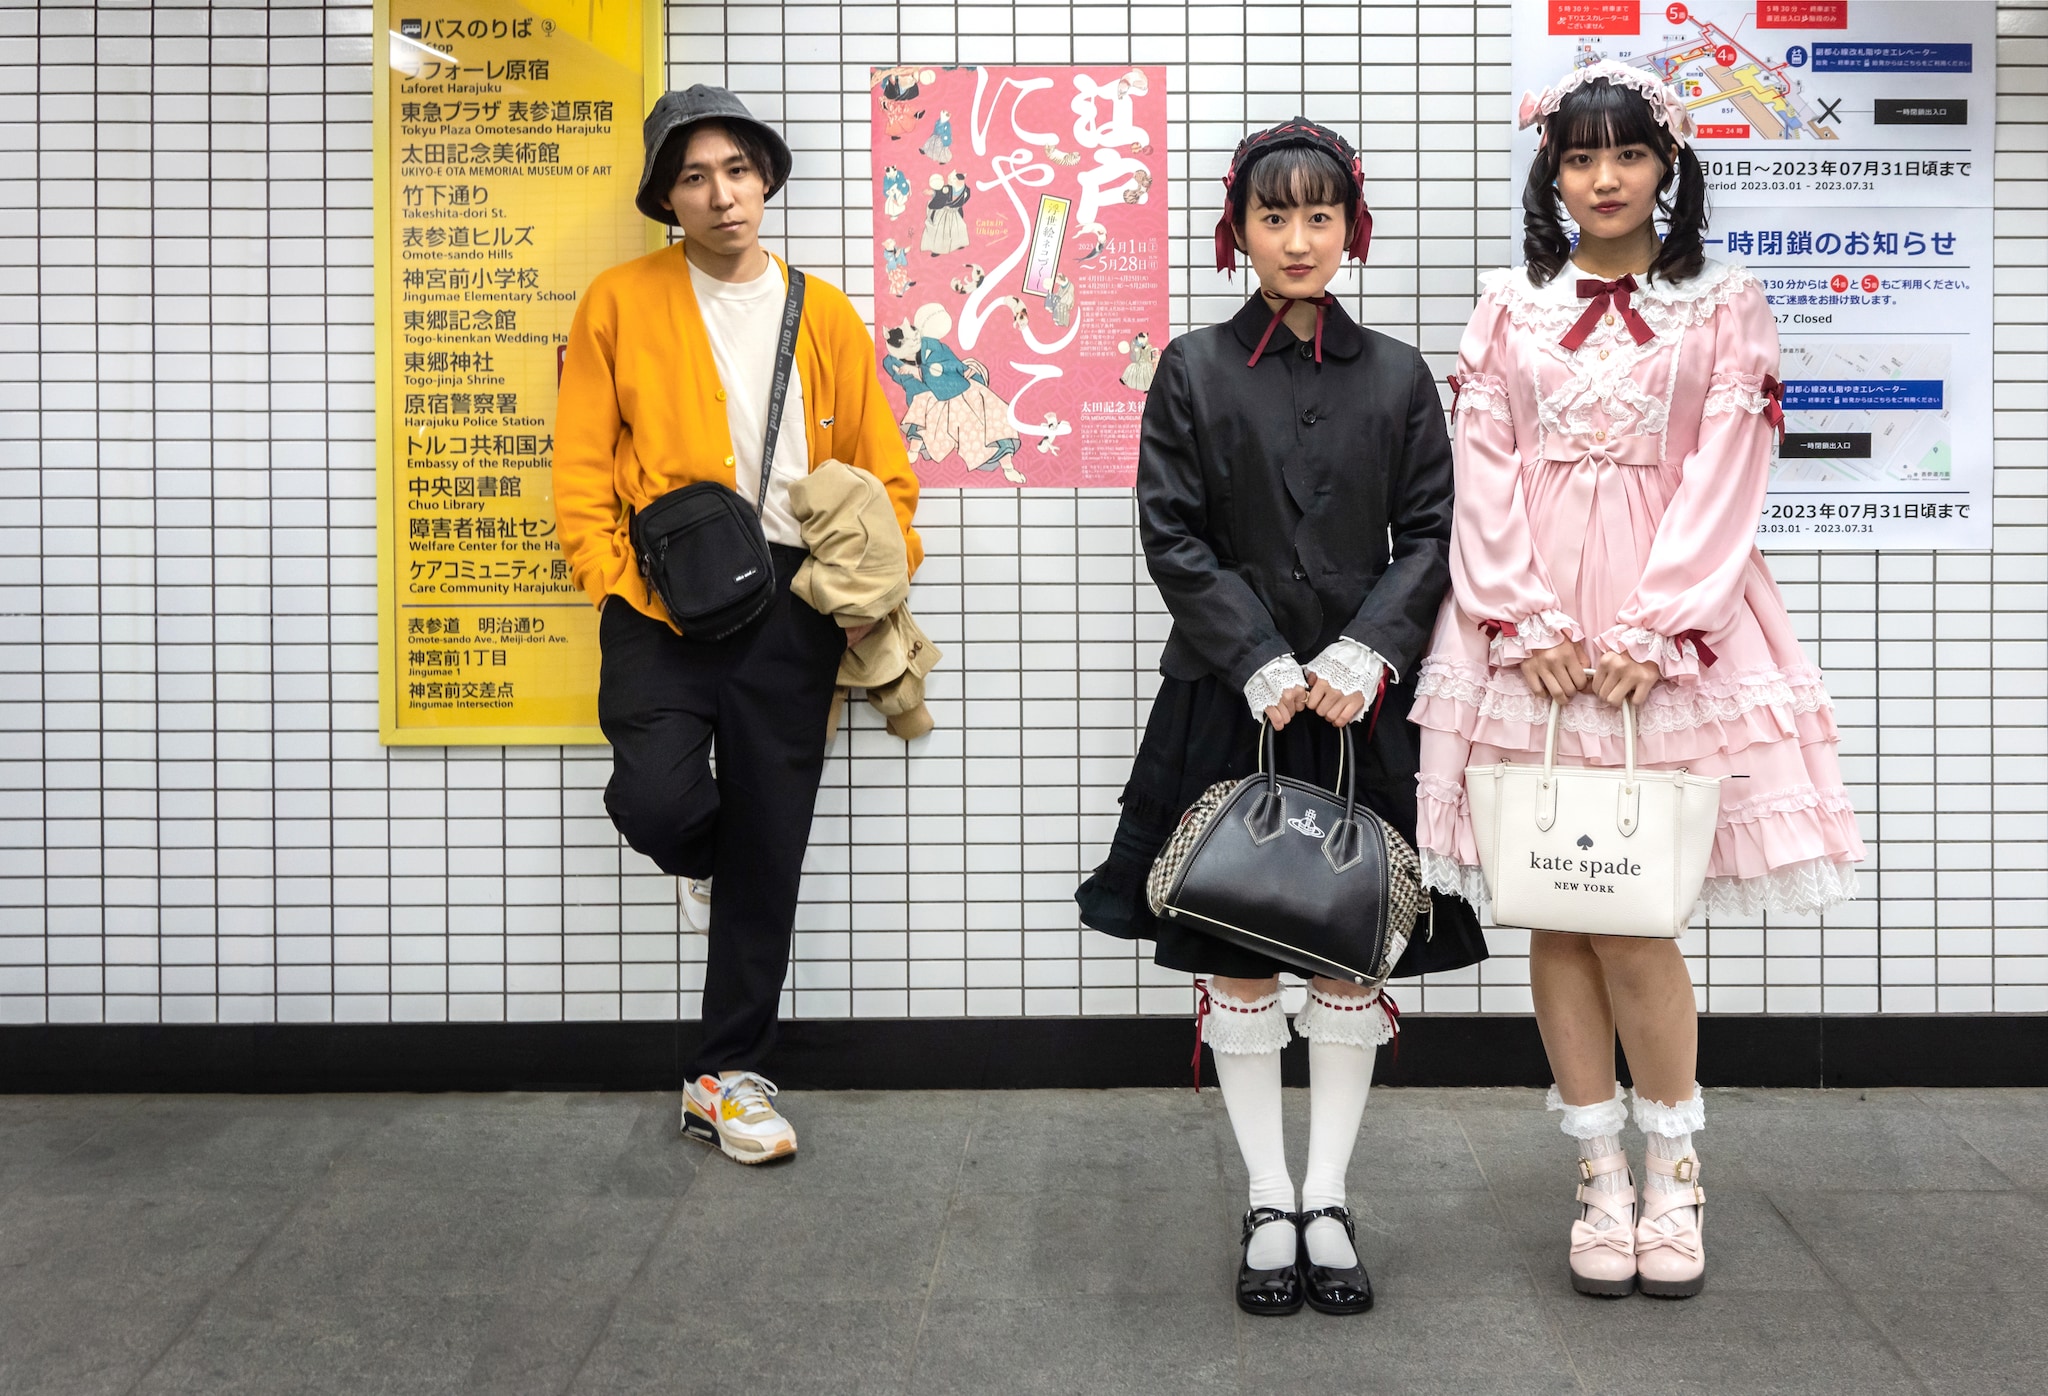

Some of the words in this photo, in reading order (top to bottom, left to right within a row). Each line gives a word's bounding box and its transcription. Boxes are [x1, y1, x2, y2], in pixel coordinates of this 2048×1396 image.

[424, 18, 532, 38] バスのりば
[403, 59, 549, 81] ラフォーレ原宿
[401, 83, 443, 94] Laforet
[448, 83, 502, 95] Harajuku
[401, 101, 501, 122] 東急プラザ
[508, 101, 613, 122] 表参道原宿
[401, 125, 437, 138] Tokyu
[440, 125, 471, 135] Plaza
[475, 125, 553, 135] Omotesando
[556, 124, 611, 136] Harajuku
[401, 142, 560, 164] 太田記念美術館
[401, 166, 442, 177] UKIYO-E
[446, 166, 466, 177] OTA
[470, 166, 524, 176] MEMORIAL
[527, 166, 573, 176] MUSEUM
[577, 166, 590, 176] OF
[592, 166, 612, 176] ART
[1741, 181, 1802, 191] 2023.03.01
[1815, 181, 1875, 191] 2023.07.31
[403, 185, 488, 206] 竹下通り
[402, 208, 487, 218] Takeshita-dori
[491, 208, 507, 218] St.
[402, 226, 535, 248] 表参道ヒルズ
[1703, 231, 1956, 256] 一時閉鎖のお知らせ
[402, 250, 484, 260] Omote-sando
[488, 250, 514, 260] Hills
[402, 267, 539, 289] 神宮前小学校
[402, 291, 460, 304] Jingumae
[464, 291, 532, 303] Elementary
[537, 290, 576, 301] School
[404, 309, 516, 331] 東郷記念館
[785, 299, 799, 327] niko
[1793, 314, 1833, 324] Closed
[404, 333, 491, 346] Togo-kinenkan
[494, 333, 548, 345] Wedding
[781, 329, 792, 357] and
[404, 351, 494, 373] 東郷神社
[404, 375, 463, 387] Togo-jinja
[467, 375, 505, 385] Shrine
[774, 371, 786, 399] niko
[404, 393, 517, 415] 原宿警察署
[405, 417, 459, 429] Harajuku
[463, 417, 498, 426] Police
[502, 417, 545, 426] Station
[769, 404, 779, 431] and
[408, 434, 554, 456] トルコ共和国大
[408, 458, 458, 470] Embassy
[463, 458, 476, 468] of
[479, 458, 499, 468] the
[502, 457, 553, 470] Republic
[409, 476, 521, 498] 中央図書館
[408, 500, 440, 510] Chuo
[443, 500, 485, 512] Library
[410, 517, 556, 539] 障害者福祉セン
[1814, 524, 1874, 533] 2023.07.31
[409, 541, 455, 551] Welfare
[458, 541, 498, 551] Center
[501, 541, 519, 551] for
[522, 541, 541, 551] the
[410, 559, 573, 580] ケアコミュニティ・原
[409, 583, 436, 593] Care
[440, 583, 509, 595] Community
[408, 617, 460, 634] 表参道
[478, 617, 545, 634] 明治通り
[408, 636, 471, 644] Omote-sando
[500, 635, 545, 645] Meiji-dori
[548, 635, 569, 643] Ave.
[408, 650, 506, 666] 神宮前1丁目
[408, 668, 453, 678] Jingumae
[456, 668, 461, 676] 1
[408, 682, 514, 699] 神宮前交差点
[409, 700, 454, 711] Jingumae
[457, 700, 514, 709] Intersection
[1529, 851, 1573, 871] kate
[1579, 857, 1641, 879] spade
[1554, 881, 1579, 891] NEW
[1583, 883, 1615, 894] YORK
